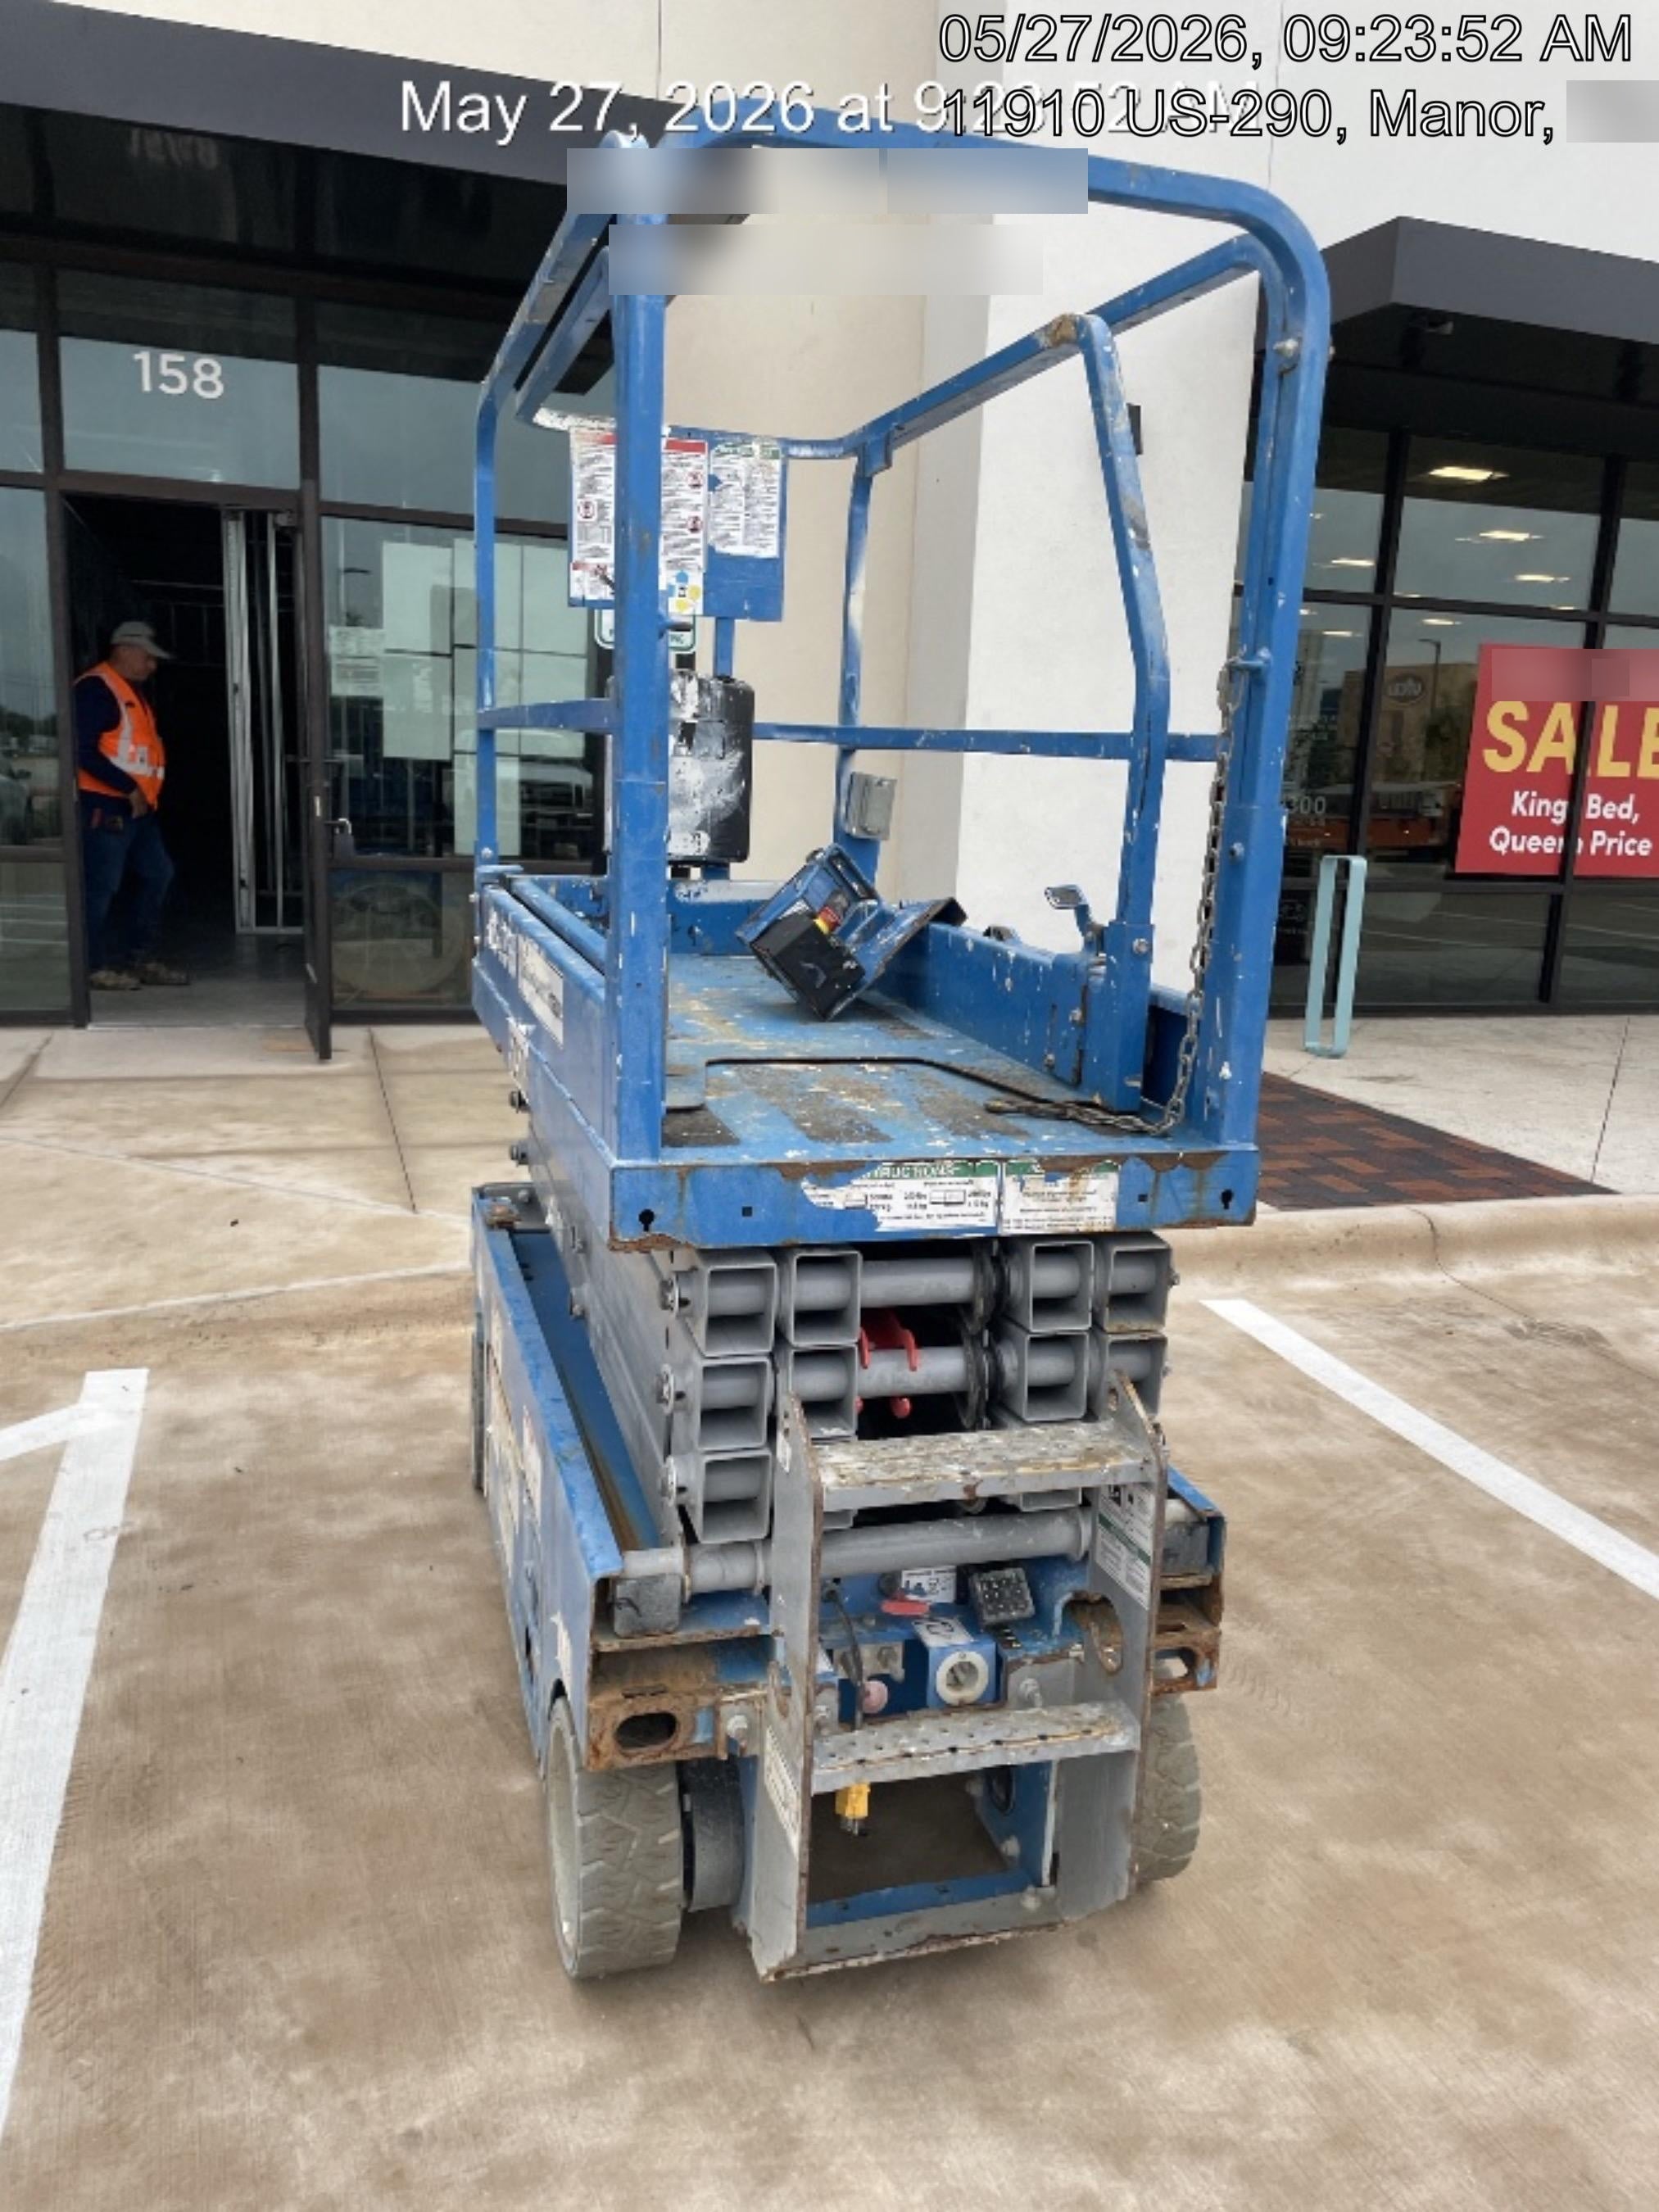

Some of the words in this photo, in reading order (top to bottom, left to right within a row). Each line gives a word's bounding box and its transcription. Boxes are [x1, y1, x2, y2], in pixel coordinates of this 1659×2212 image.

[134, 351, 224, 399] 158
[1483, 700, 1659, 779] SALE
[1512, 790, 1569, 826] King
[1585, 793, 1639, 826] Bed,
[1589, 829, 1653, 857] Price
